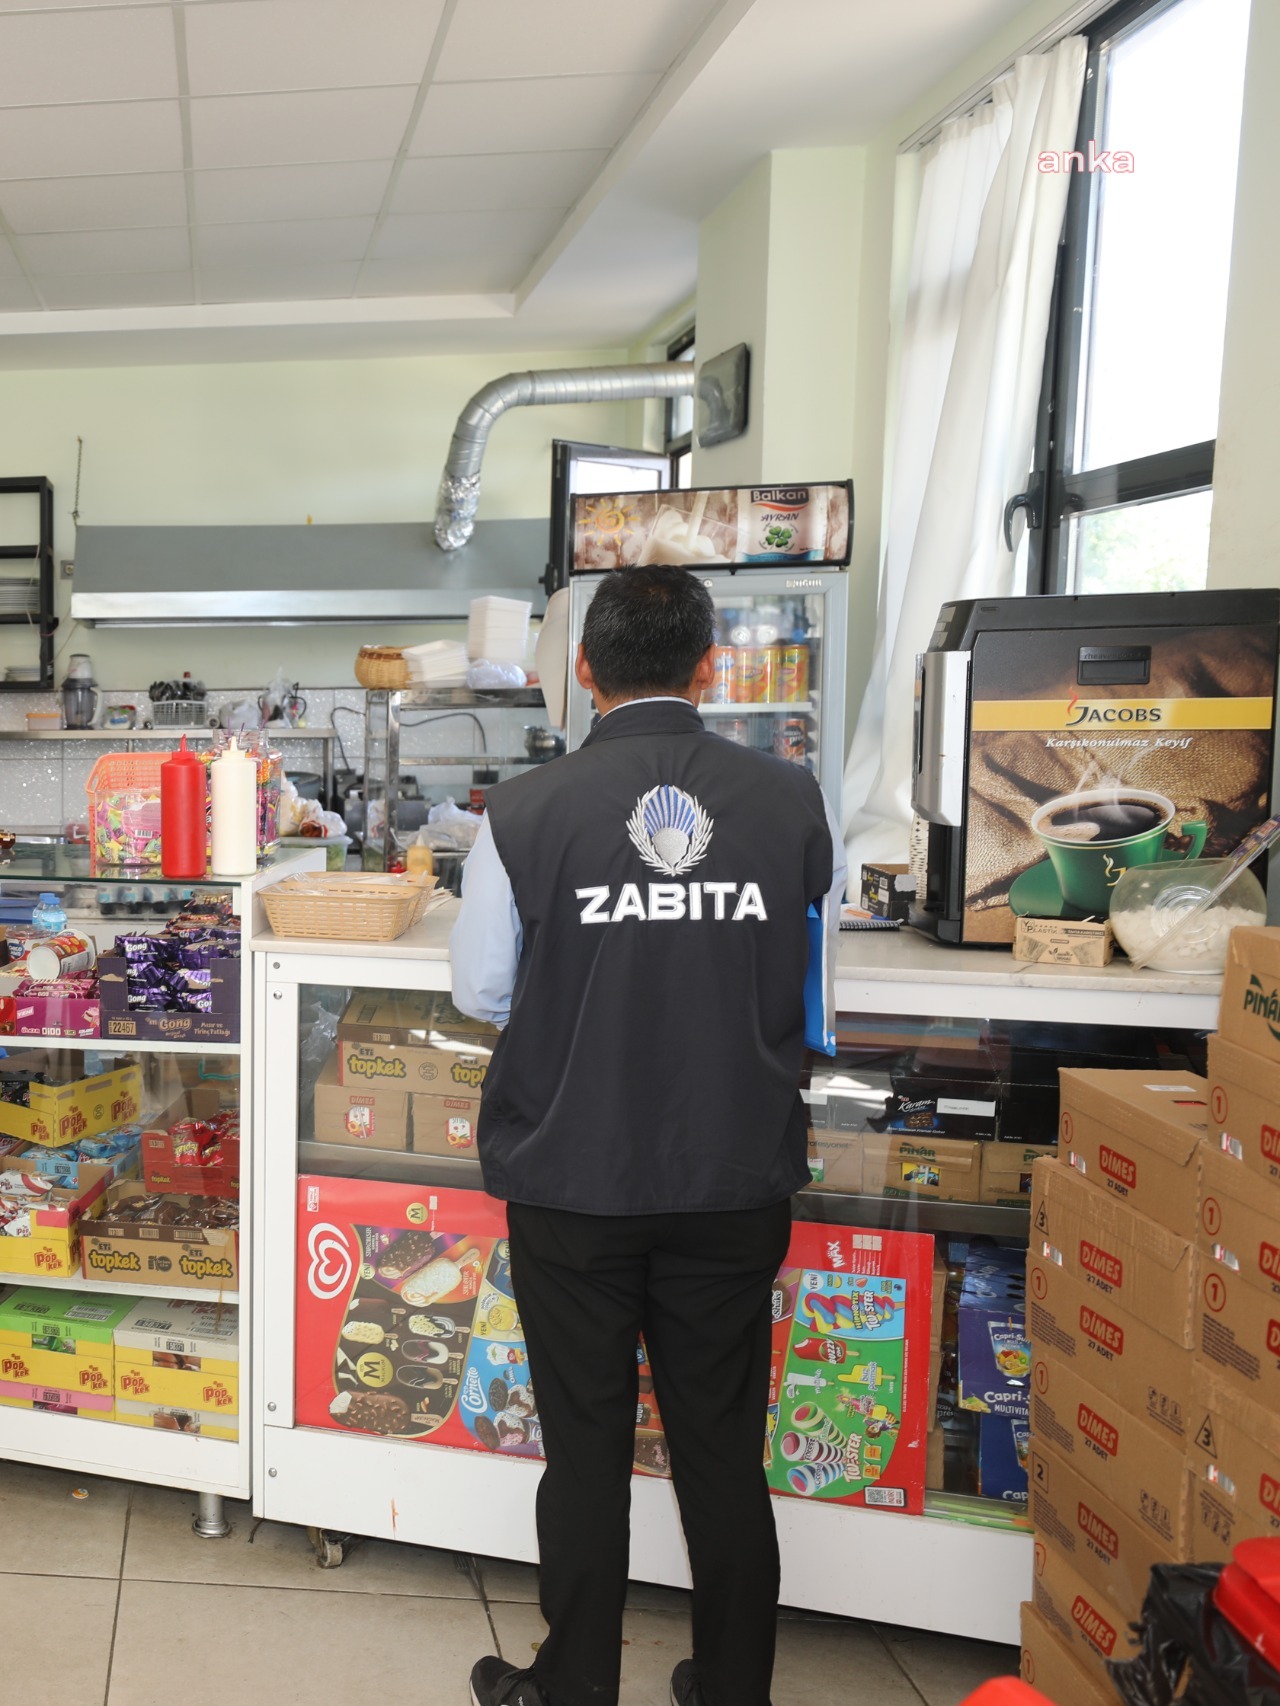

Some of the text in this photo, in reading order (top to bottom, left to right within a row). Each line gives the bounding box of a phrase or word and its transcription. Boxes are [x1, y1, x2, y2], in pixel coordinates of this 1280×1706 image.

[752, 489, 807, 501] Balkan
[1066, 706, 1162, 726] JACOBS
[1154, 736, 1194, 749] Keyif
[575, 881, 769, 925] ZABITA
[126, 942, 147, 952] Gong
[127, 995, 147, 1004] Gong
[112, 1022, 135, 1034] 22467
[159, 1017, 192, 1031] Gong
[347, 1054, 406, 1079] topkek
[451, 1062, 488, 1088] top
[808, 1140, 849, 1150] ofesyonel
[1100, 1148, 1135, 1185] DİMES
[89, 1250, 141, 1273] topkek
[179, 1257, 234, 1279] topkek
[1081, 1243, 1121, 1284] DİMES
[807, 1272, 818, 1291] YENİ
[1096, 1278, 1114, 1295] ADET
[1081, 1308, 1121, 1350] DİMES
[826, 1338, 838, 1365] BUZZY
[1096, 1343, 1114, 1362] ADET
[461, 1366, 488, 1414] Cornetto
[984, 1390, 1030, 1405] Capri-
[994, 1404, 1030, 1416] MULTIVITA
[1079, 1407, 1117, 1451] DİMES
[1093, 1442, 1109, 1462] ADET
[1079, 1507, 1118, 1554] DİMES
[1094, 1544, 1111, 1565] ADET
[1074, 1600, 1114, 1651] DİMES
